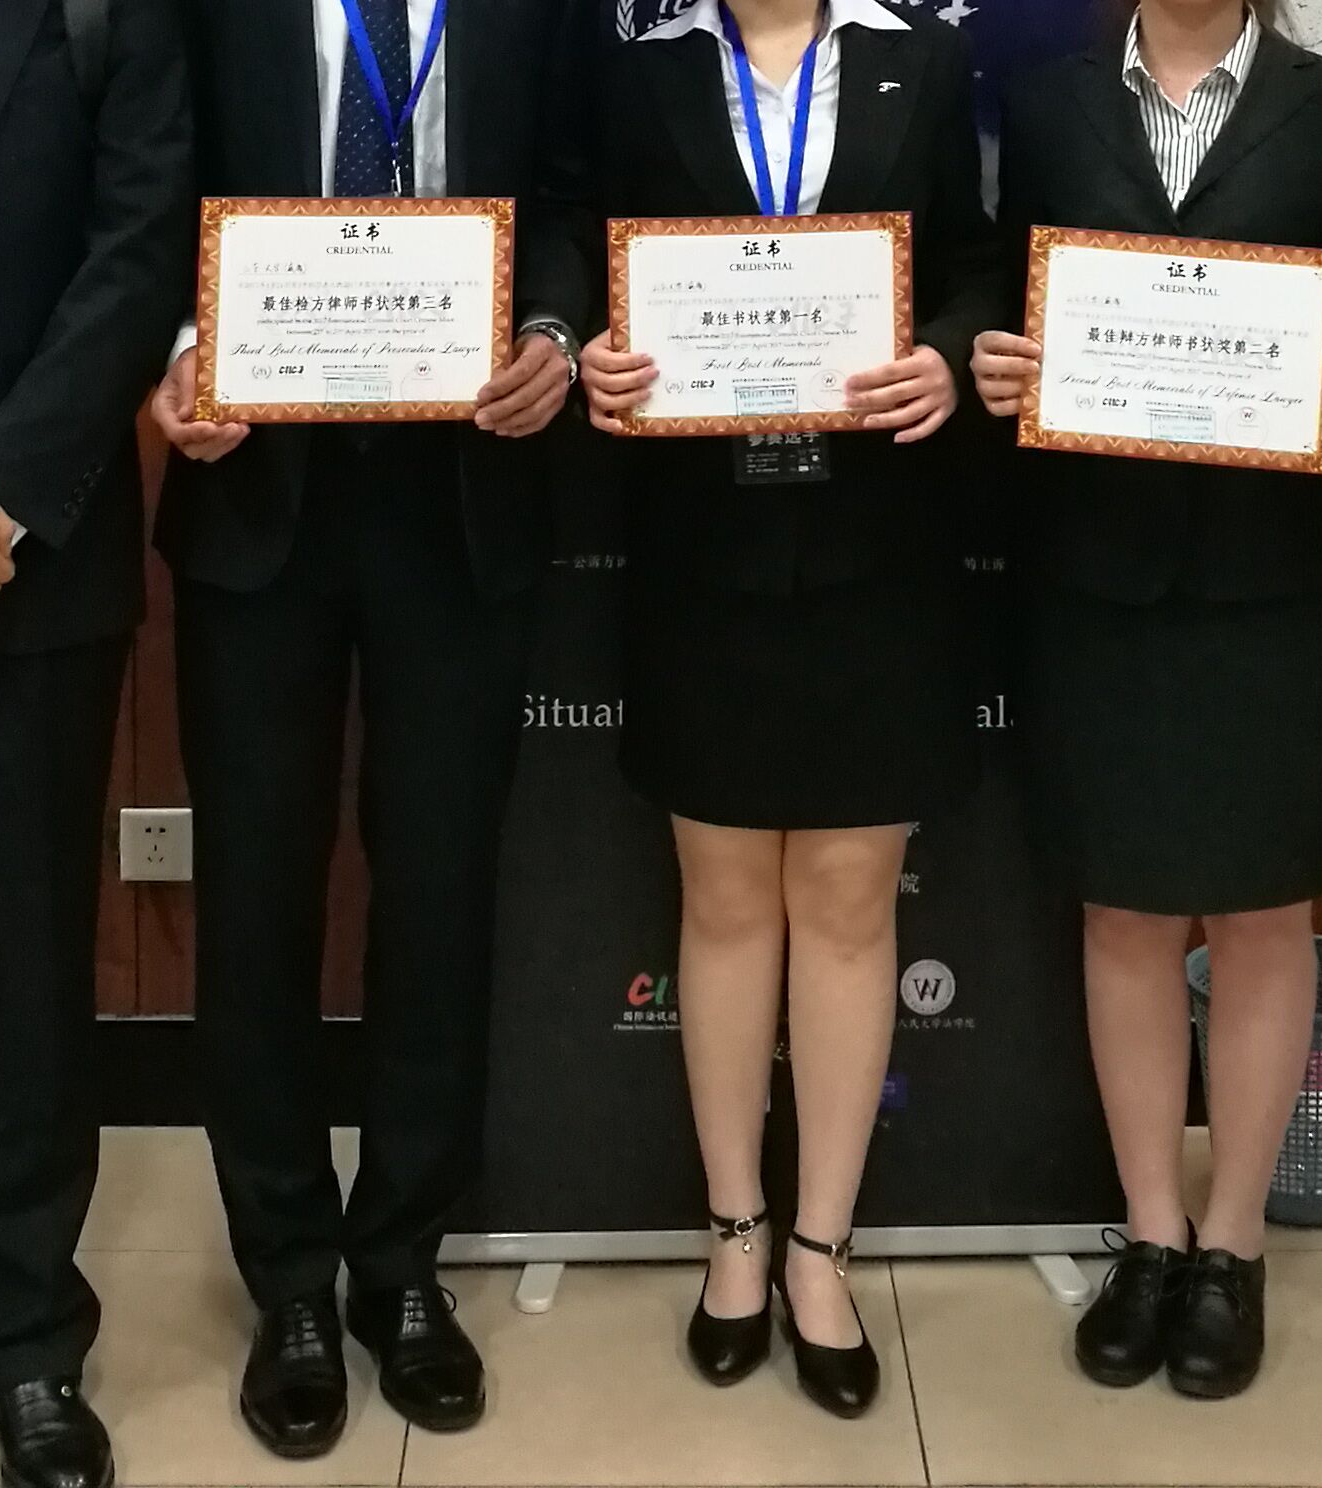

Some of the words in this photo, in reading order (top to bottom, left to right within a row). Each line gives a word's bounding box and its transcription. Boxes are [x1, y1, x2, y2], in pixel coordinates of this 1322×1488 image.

[341, 222, 380, 241] 证书
[326, 246, 393, 255] CREDENTIAL
[742, 240, 781, 258] 证书
[729, 262, 794, 272] CREDENTIAL
[1167, 262, 1208, 282] 证书
[1151, 283, 1220, 297] CREDENTIAL
[262, 294, 453, 313] 最佳检方律师书状奖第三名
[700, 308, 823, 326] 最佳书状奖第一名
